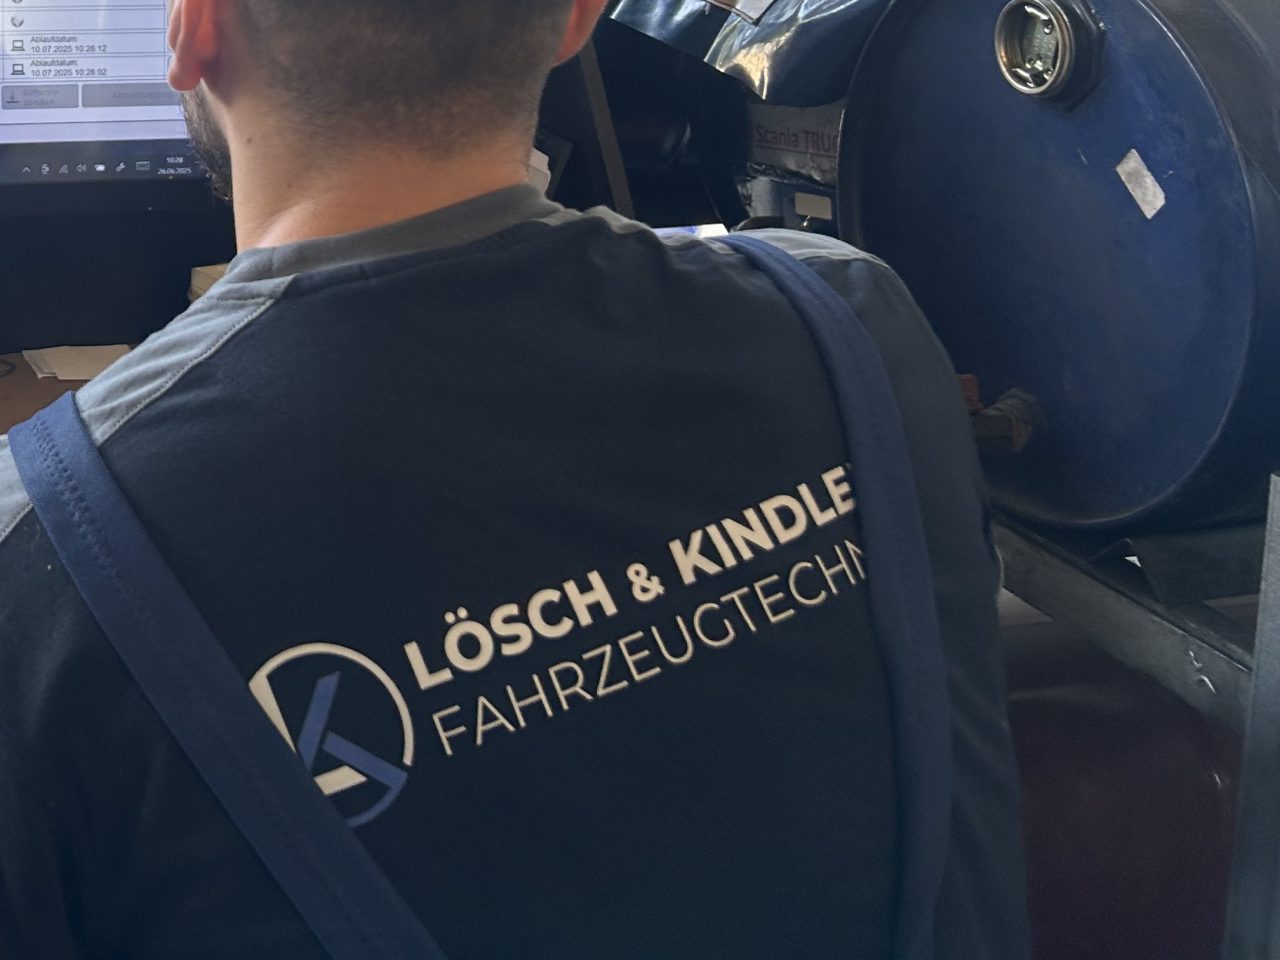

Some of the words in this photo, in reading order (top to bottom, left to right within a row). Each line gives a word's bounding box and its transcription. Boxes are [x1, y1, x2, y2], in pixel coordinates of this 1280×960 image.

[755, 123, 800, 148] Scania
[404, 570, 617, 690] LÖSCH
[625, 562, 664, 603] &
[668, 464, 856, 586] KINDLE
